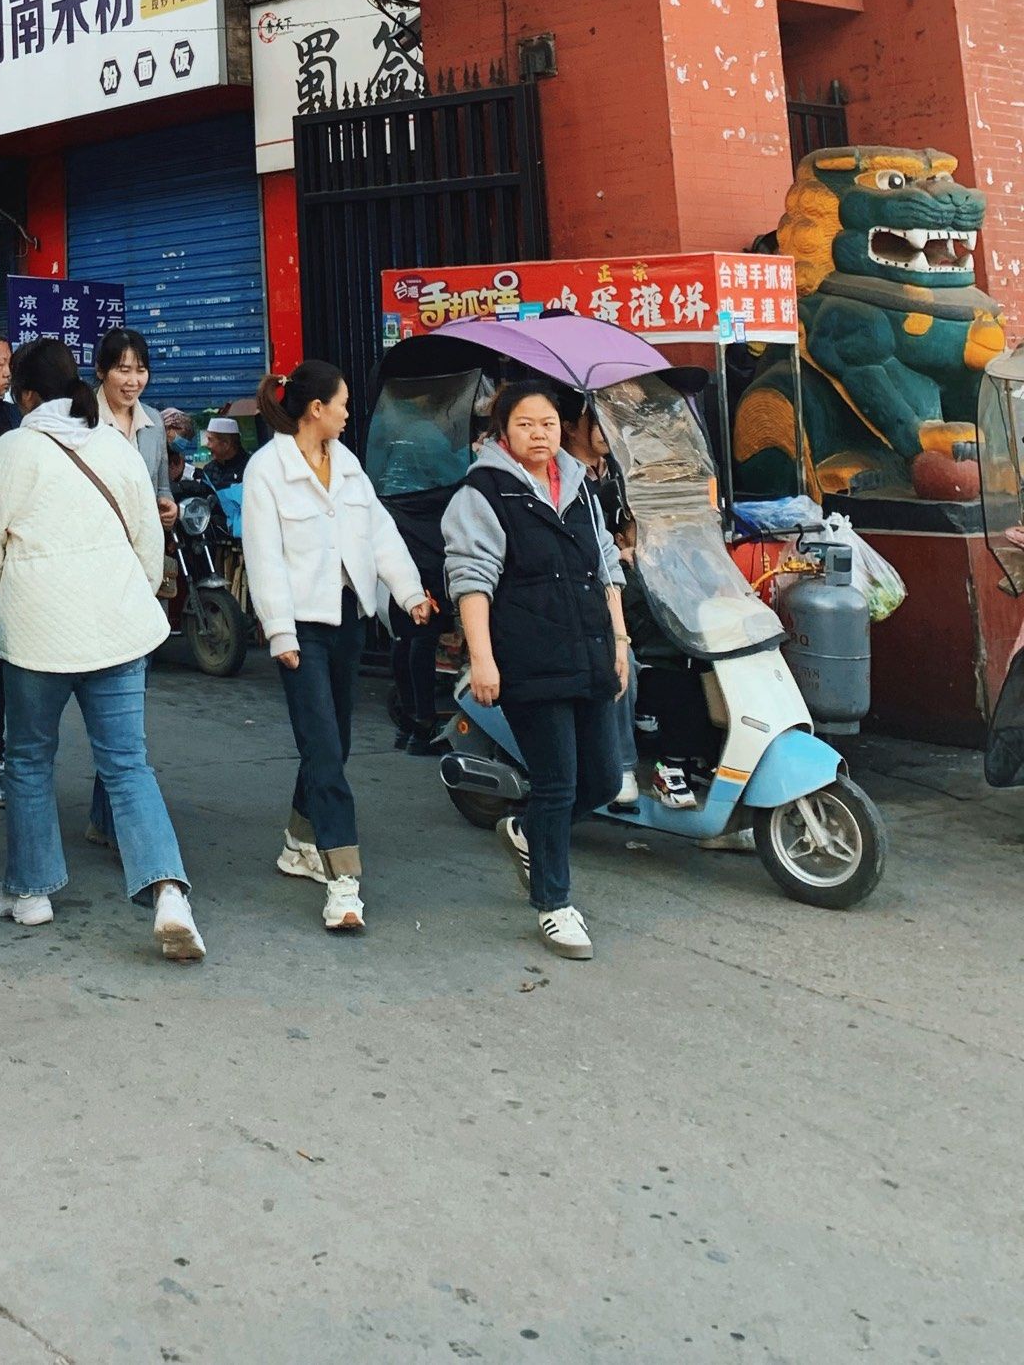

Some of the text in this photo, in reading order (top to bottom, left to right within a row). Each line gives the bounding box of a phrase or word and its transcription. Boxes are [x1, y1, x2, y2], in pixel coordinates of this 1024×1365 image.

[719, 262, 793, 290] 台湾手抓饼
[96, 298, 124, 312] 7元
[96, 316, 125, 329] 7元
